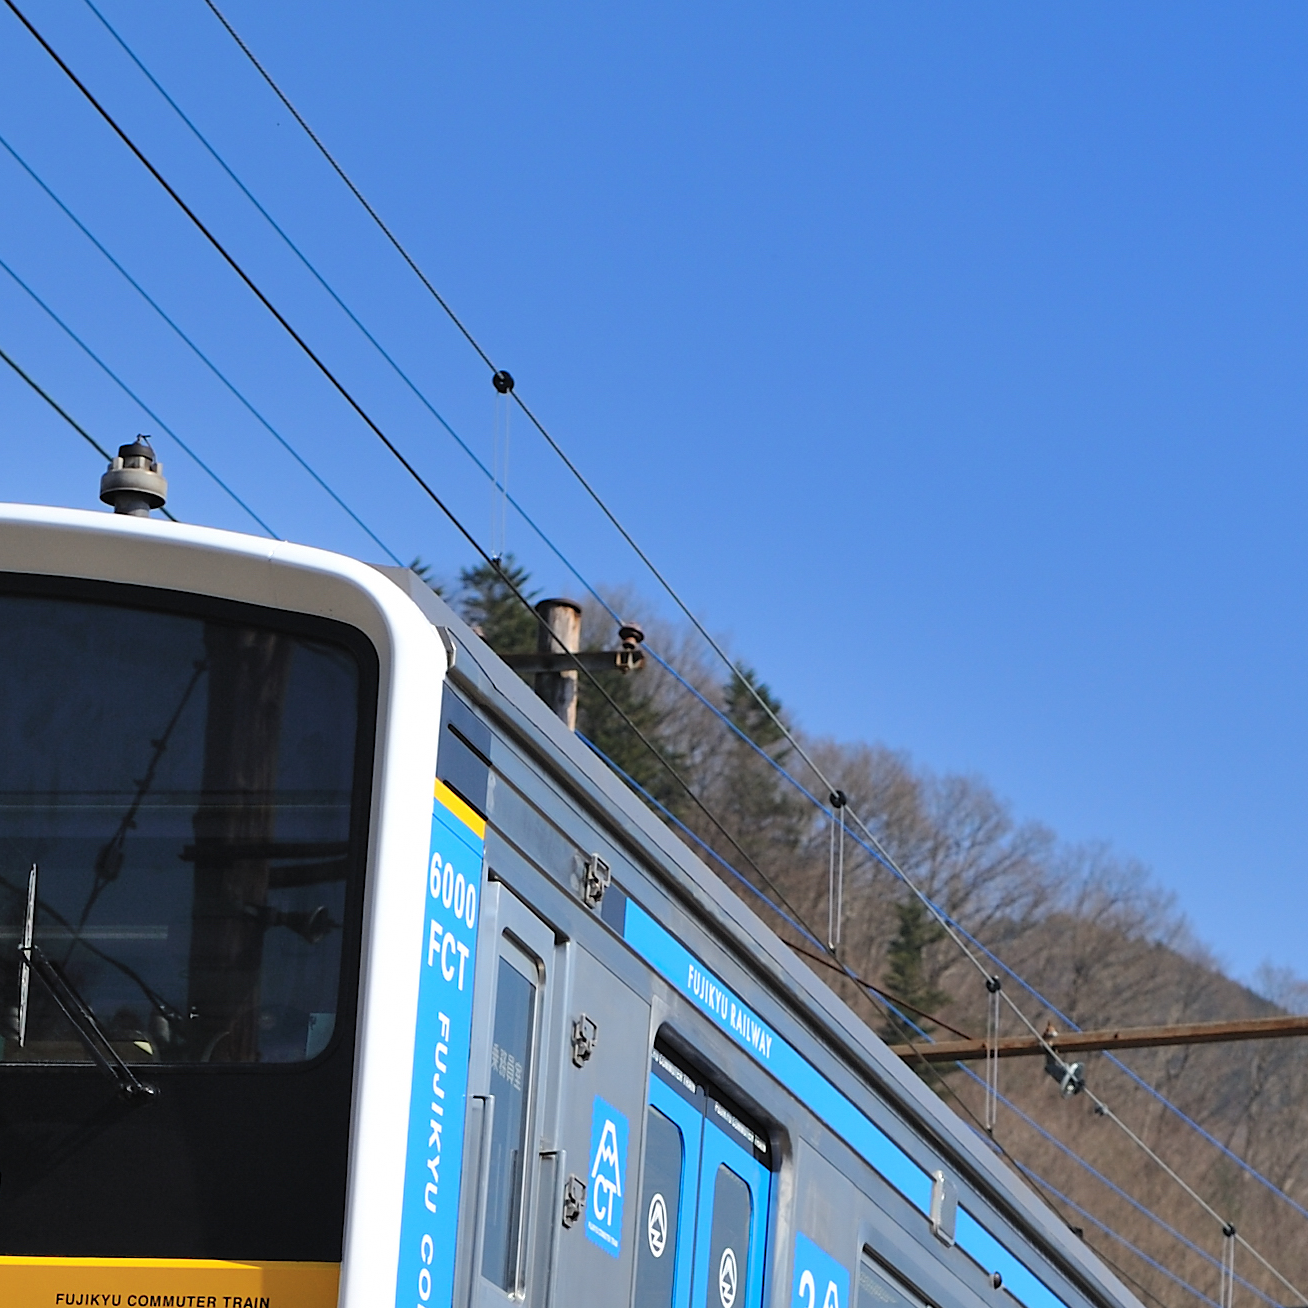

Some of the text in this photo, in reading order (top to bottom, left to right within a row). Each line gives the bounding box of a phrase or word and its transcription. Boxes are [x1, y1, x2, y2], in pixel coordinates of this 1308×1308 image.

[429, 852, 476, 929] 6000
[427, 918, 470, 991] FCT
[687, 964, 773, 1059] FUJIKYU RAILWAY
[424, 1011, 450, 1214] FUJIKYU
[55, 1293, 122, 1307] FUJIKYU
[127, 1294, 217, 1308] COMMUTER
